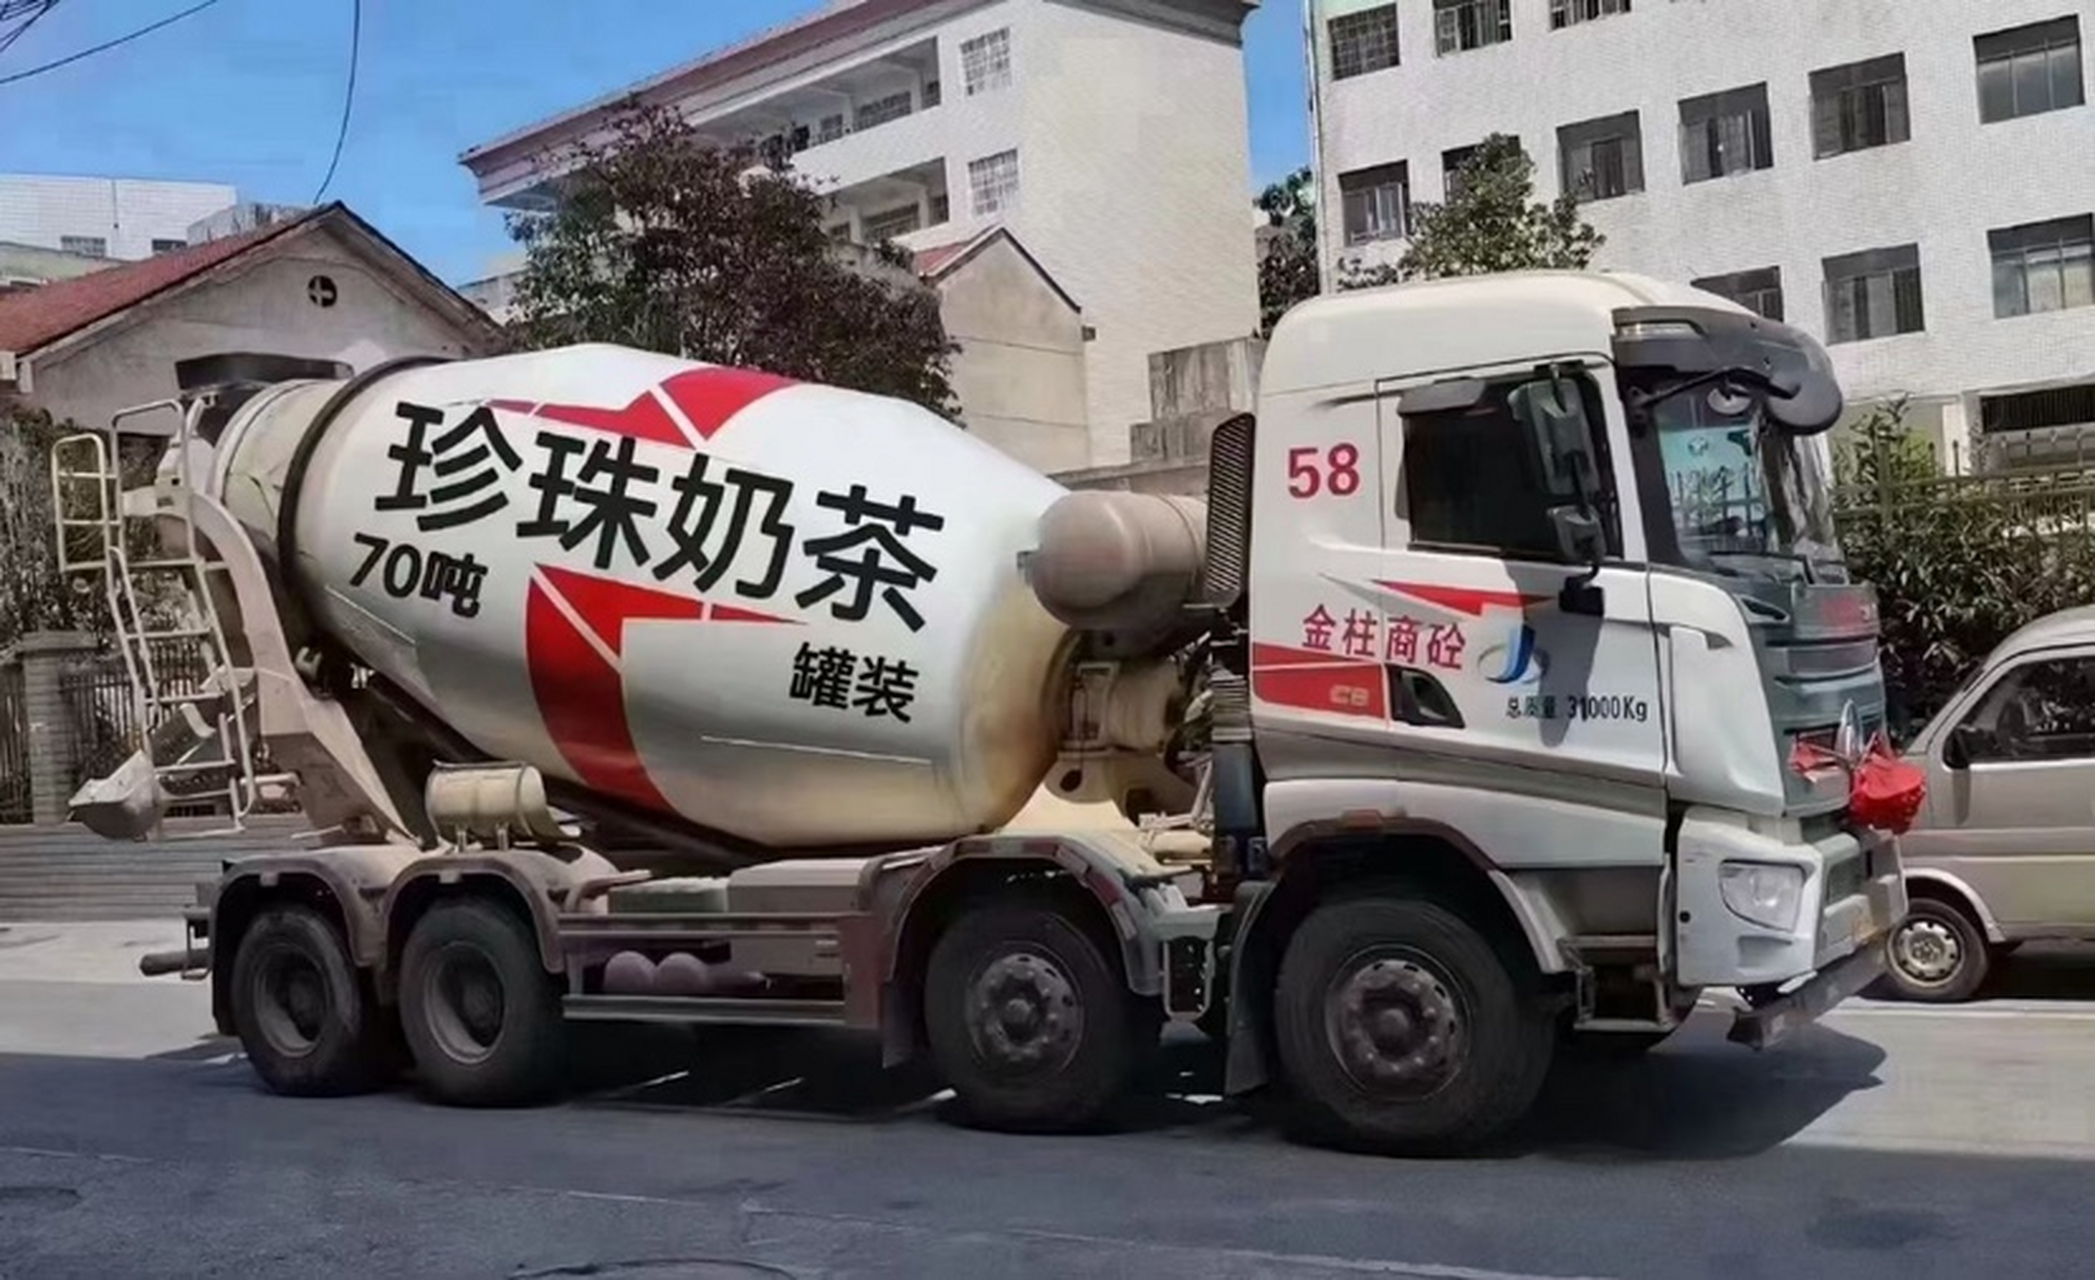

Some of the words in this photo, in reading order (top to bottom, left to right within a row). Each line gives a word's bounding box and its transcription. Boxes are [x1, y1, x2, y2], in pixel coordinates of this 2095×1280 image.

[1287, 443, 1360, 499] 58
[374, 401, 945, 633] 珍珠奶茶
[350, 532, 488, 618] 70吨
[1302, 604, 1466, 669] 金柱商砼
[790, 641, 919, 723] 罐装
[1567, 695, 1648, 722] 31000Kg
